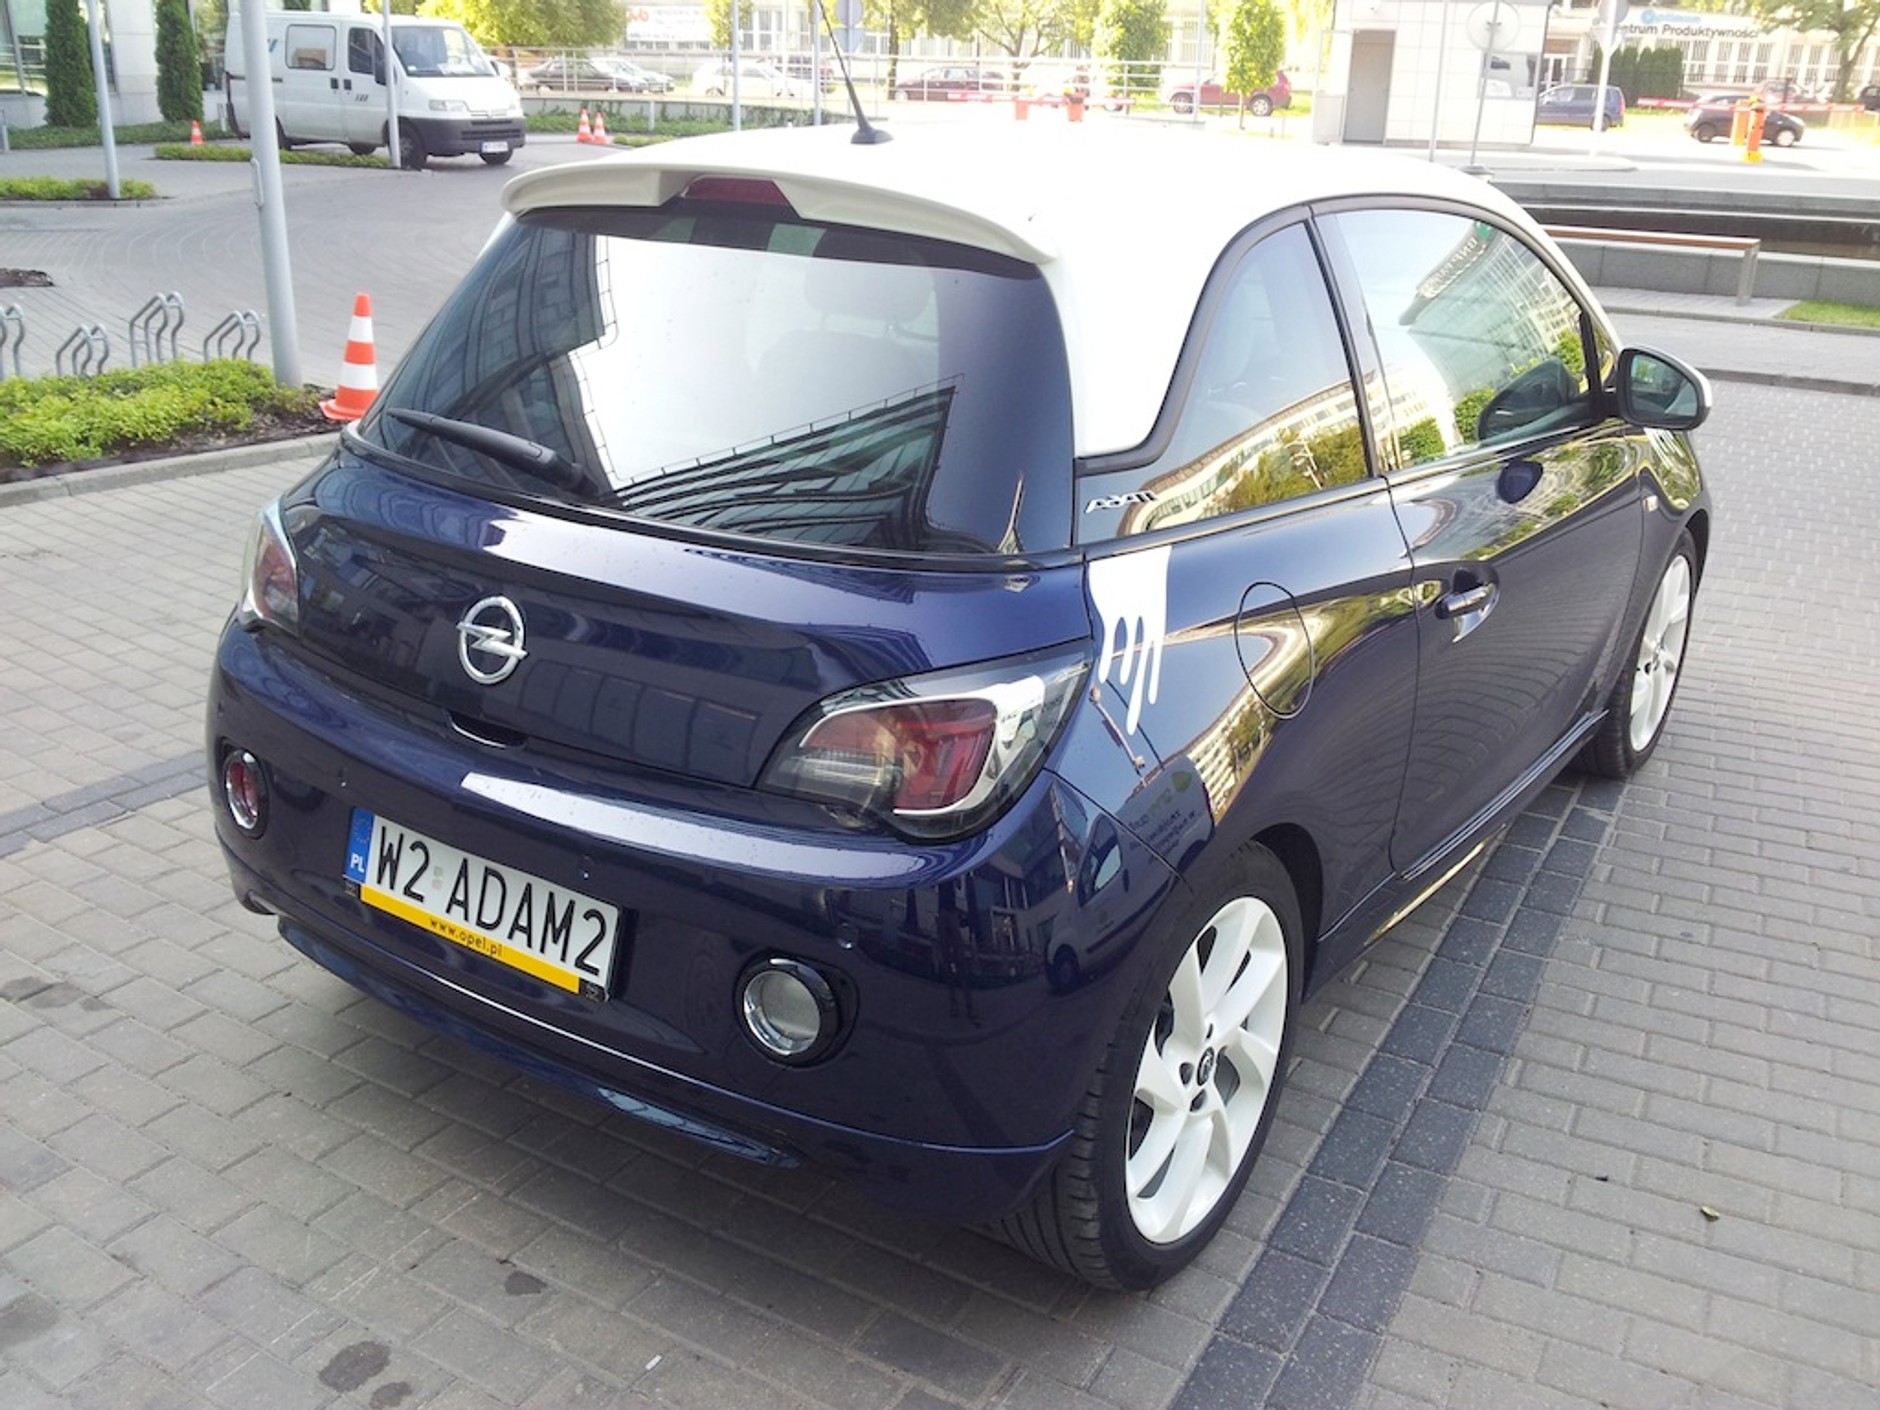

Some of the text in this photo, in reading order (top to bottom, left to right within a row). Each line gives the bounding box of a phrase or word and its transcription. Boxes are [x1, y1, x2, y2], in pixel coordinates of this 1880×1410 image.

[1615, 23, 1658, 35] ntrum
[350, 852, 365, 873] PL
[376, 825, 608, 976] W2 ADAM2
[429, 918, 503, 957] www.opel.pl
